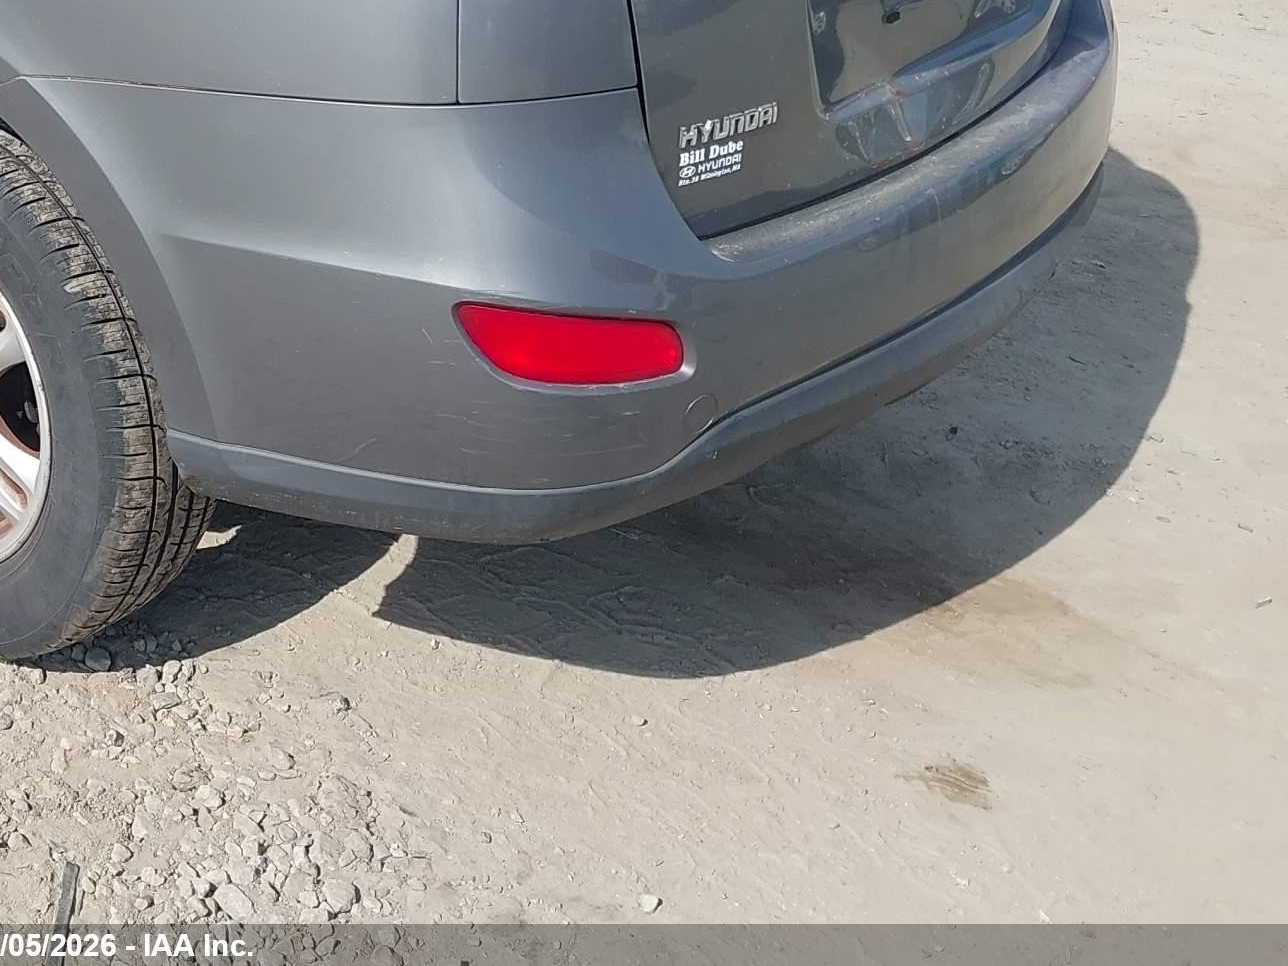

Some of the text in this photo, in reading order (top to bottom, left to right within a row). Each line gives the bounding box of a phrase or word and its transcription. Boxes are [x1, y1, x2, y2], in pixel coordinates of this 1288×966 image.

[679, 102, 778, 148] HYUNDAI
[679, 140, 744, 167] Bill Dube
[697, 153, 743, 174] HYUNDAI
